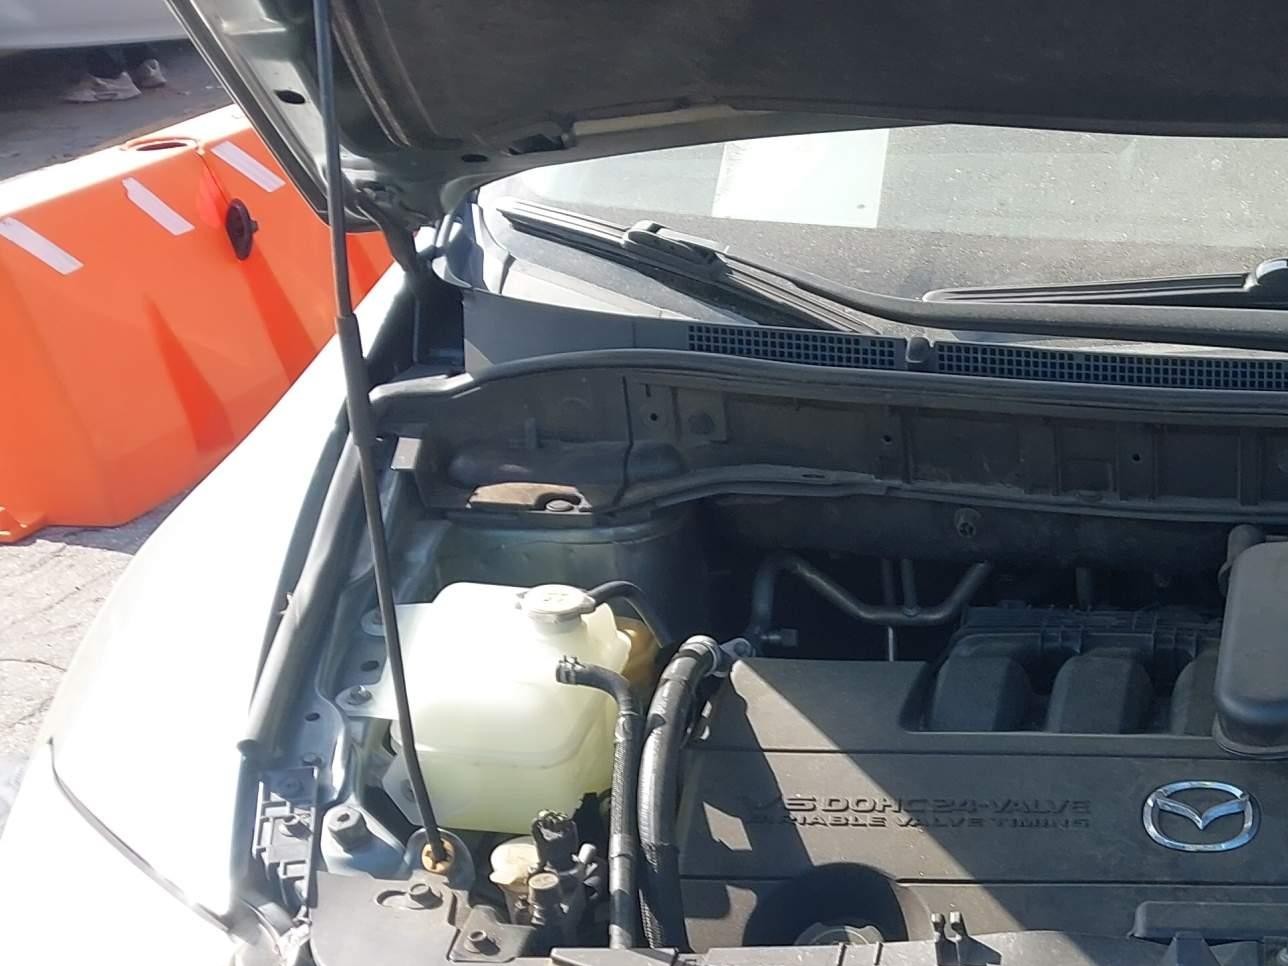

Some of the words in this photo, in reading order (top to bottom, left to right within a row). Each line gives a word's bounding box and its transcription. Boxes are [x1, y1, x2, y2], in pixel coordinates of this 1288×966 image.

[822, 797, 927, 813] DOHC
[932, 797, 1092, 814] 24-VALVE
[747, 815, 887, 828] RIABLE
